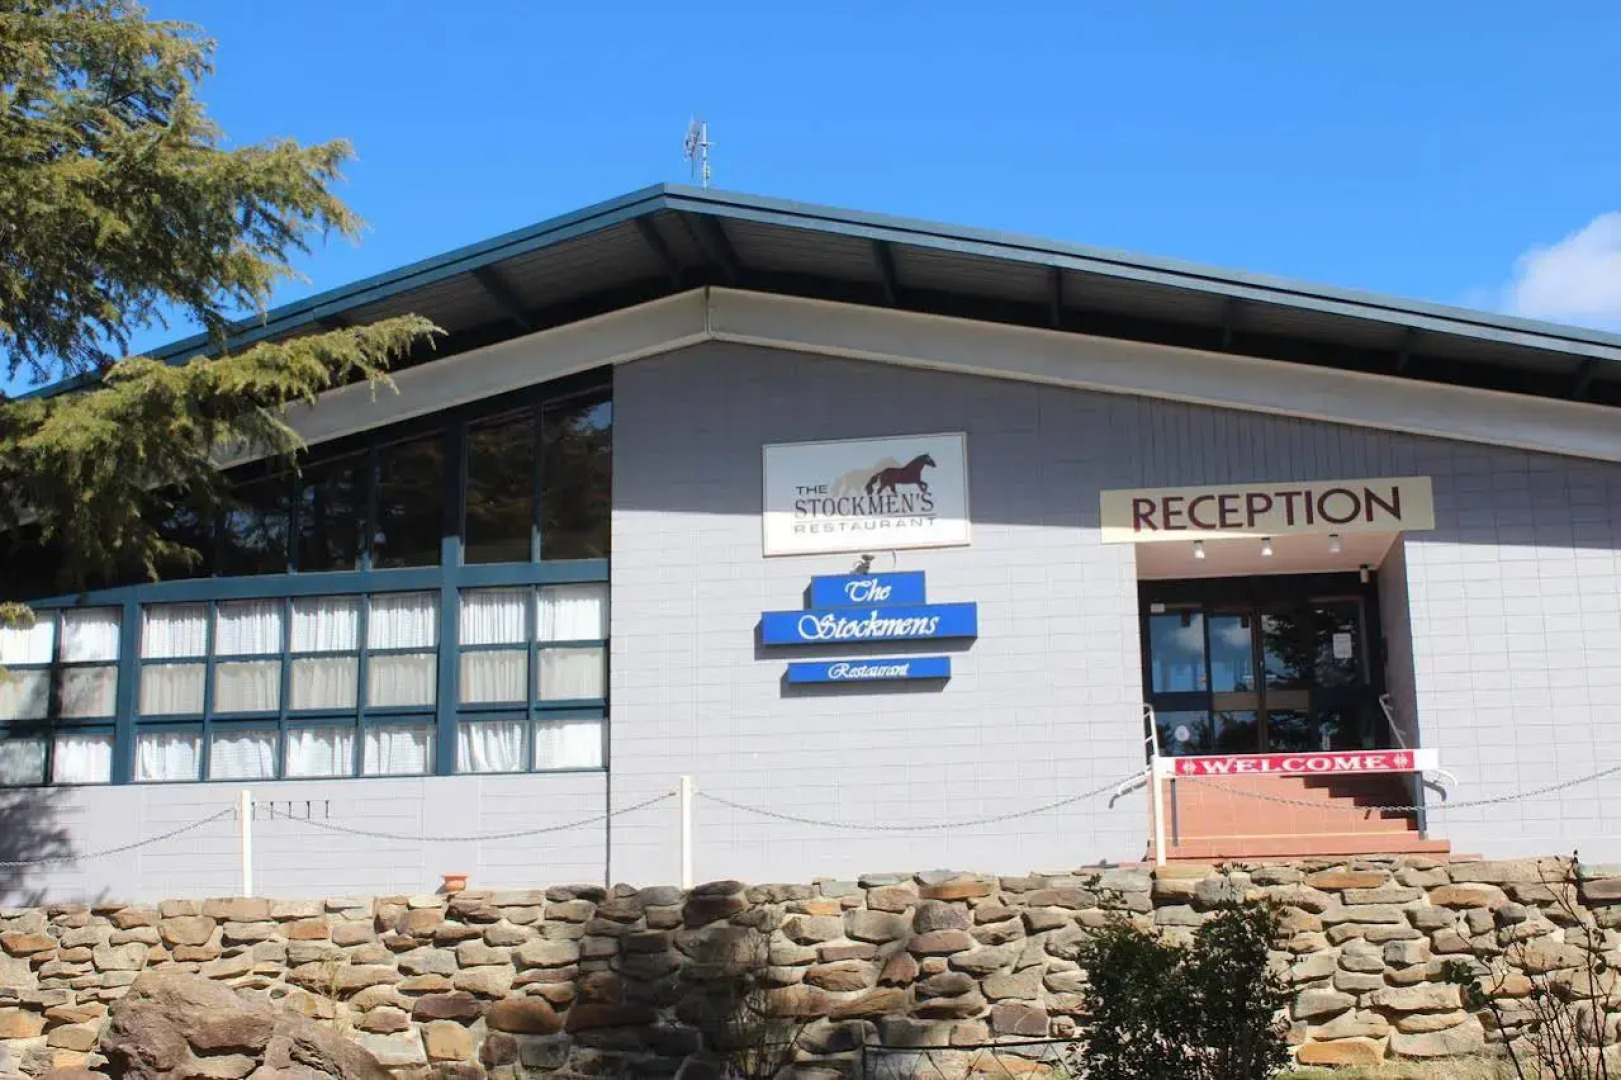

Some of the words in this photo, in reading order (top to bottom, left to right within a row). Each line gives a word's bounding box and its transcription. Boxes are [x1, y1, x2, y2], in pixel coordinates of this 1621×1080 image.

[796, 484, 827, 495] THE
[794, 492, 935, 518] STOCKMEN'S
[1132, 486, 1402, 532] RECEPTION
[793, 517, 936, 534] RESTAURANT
[845, 579, 892, 602] The
[798, 610, 941, 639] Stockmens
[828, 662, 909, 679] Restaurant
[1203, 755, 1390, 774] WELCOME
